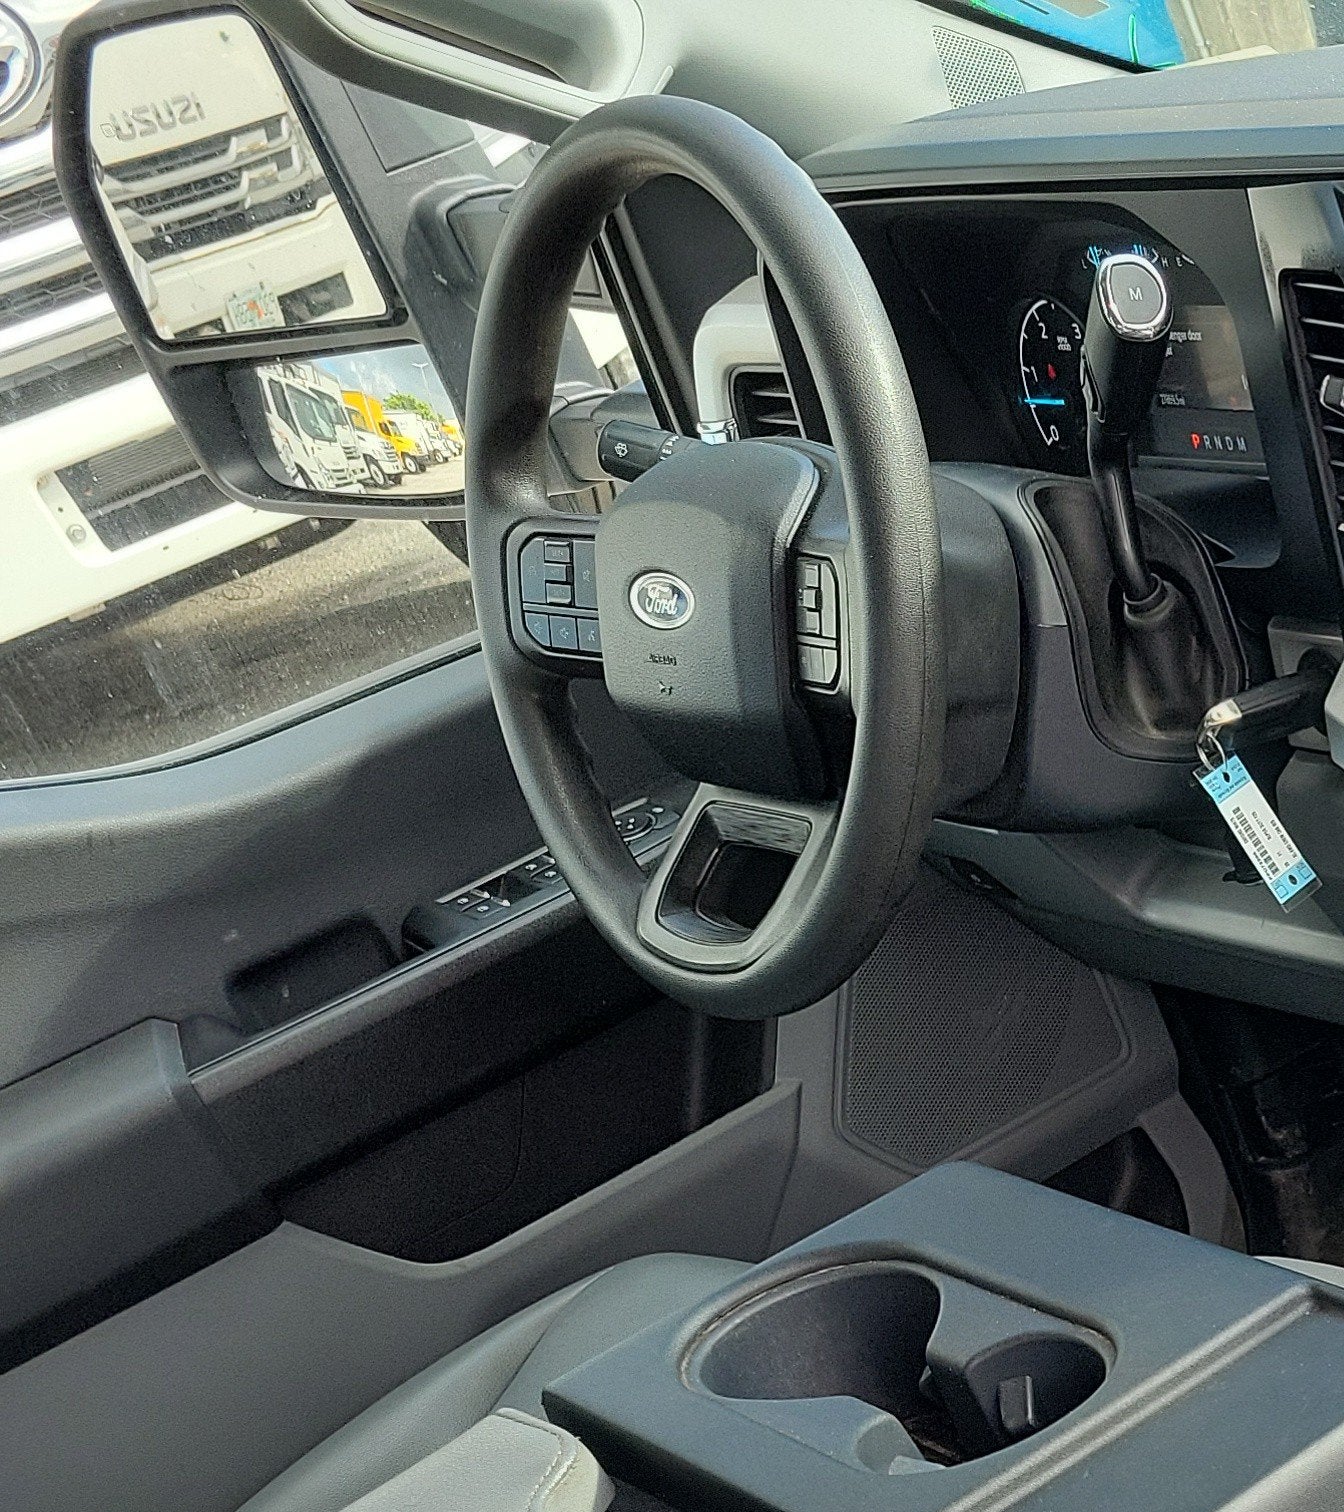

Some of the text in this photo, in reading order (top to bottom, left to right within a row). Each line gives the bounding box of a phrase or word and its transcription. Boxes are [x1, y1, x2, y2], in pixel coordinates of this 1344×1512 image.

[1128, 286, 1143, 302] M
[1038, 322, 1049, 339] 2
[1071, 323, 1082, 340] 3
[1031, 366, 1038, 382] 1
[1049, 425, 1059, 442] 0
[1191, 433, 1247, 452] P R N D M
[646, 583, 679, 616] Ford
